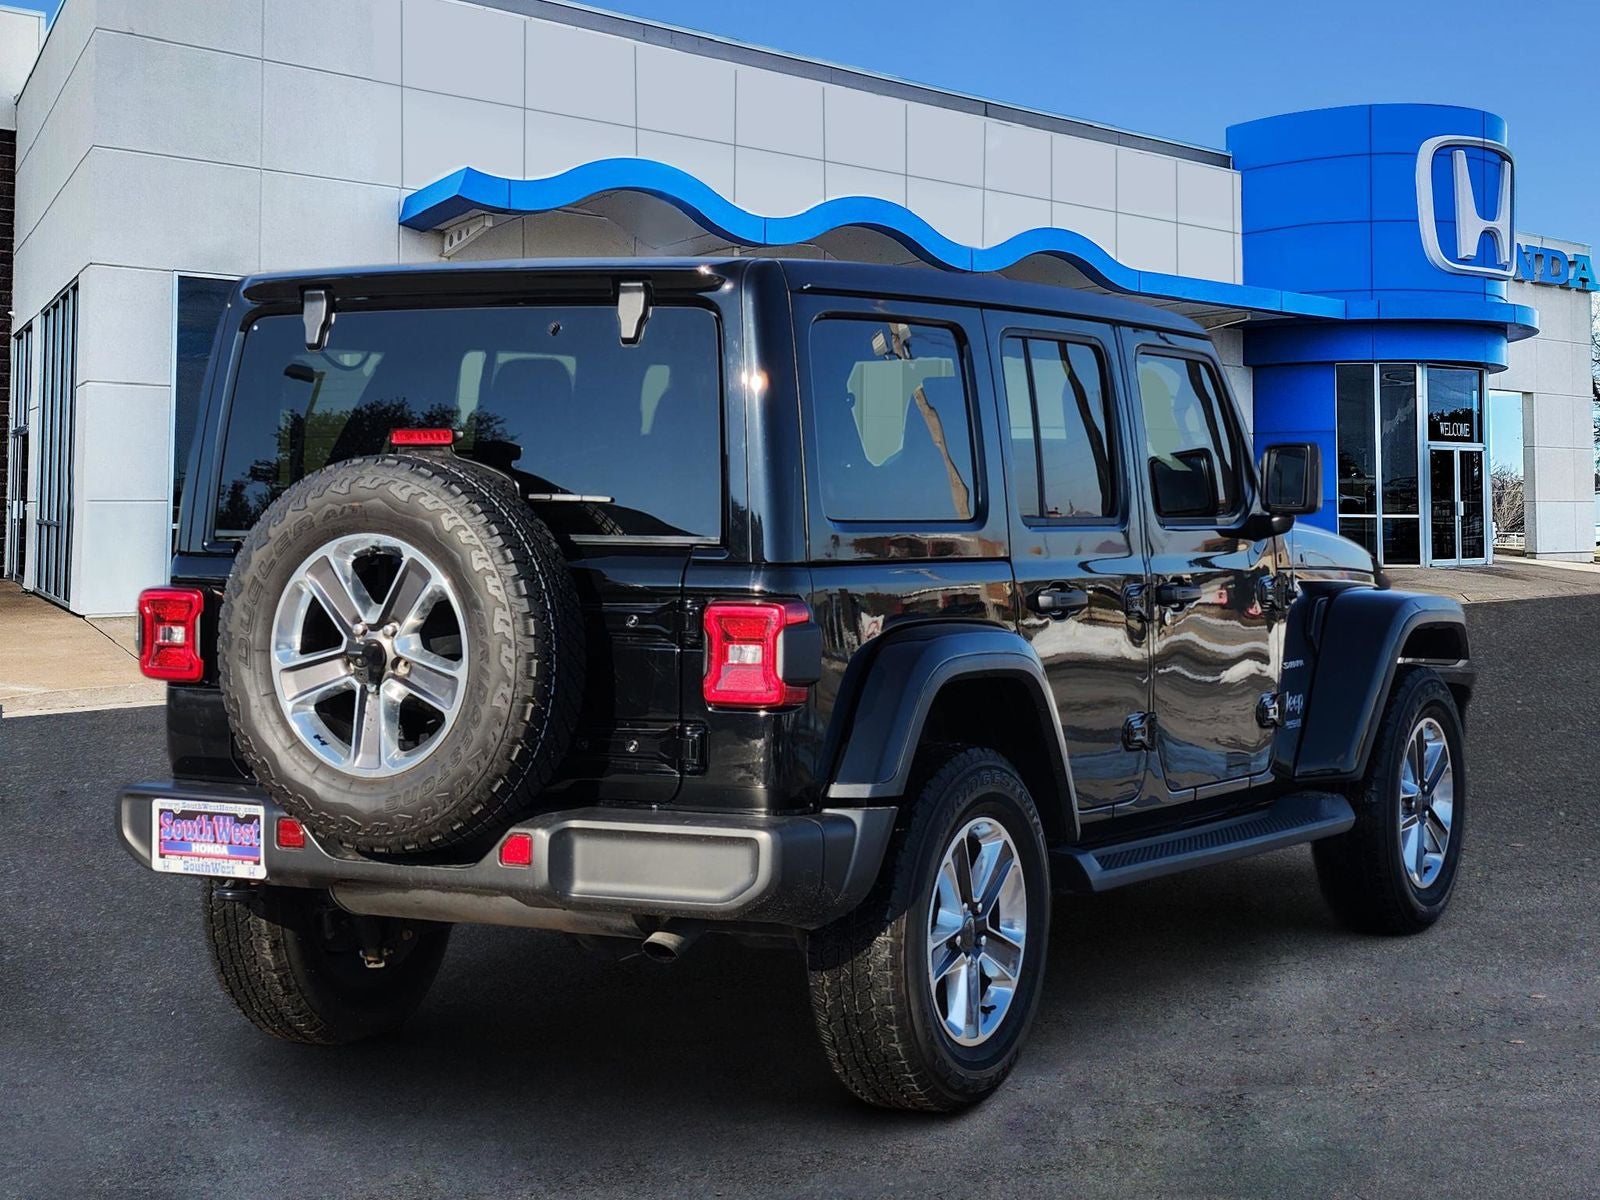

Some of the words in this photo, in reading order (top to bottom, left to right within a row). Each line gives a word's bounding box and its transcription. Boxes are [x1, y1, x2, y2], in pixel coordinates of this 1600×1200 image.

[1513, 242, 1600, 292] NDA
[1440, 422, 1471, 437] WELCOME
[237, 511, 317, 670] DUELER
[1285, 690, 1304, 715] Jeep
[191, 841, 228, 855] HONDA
